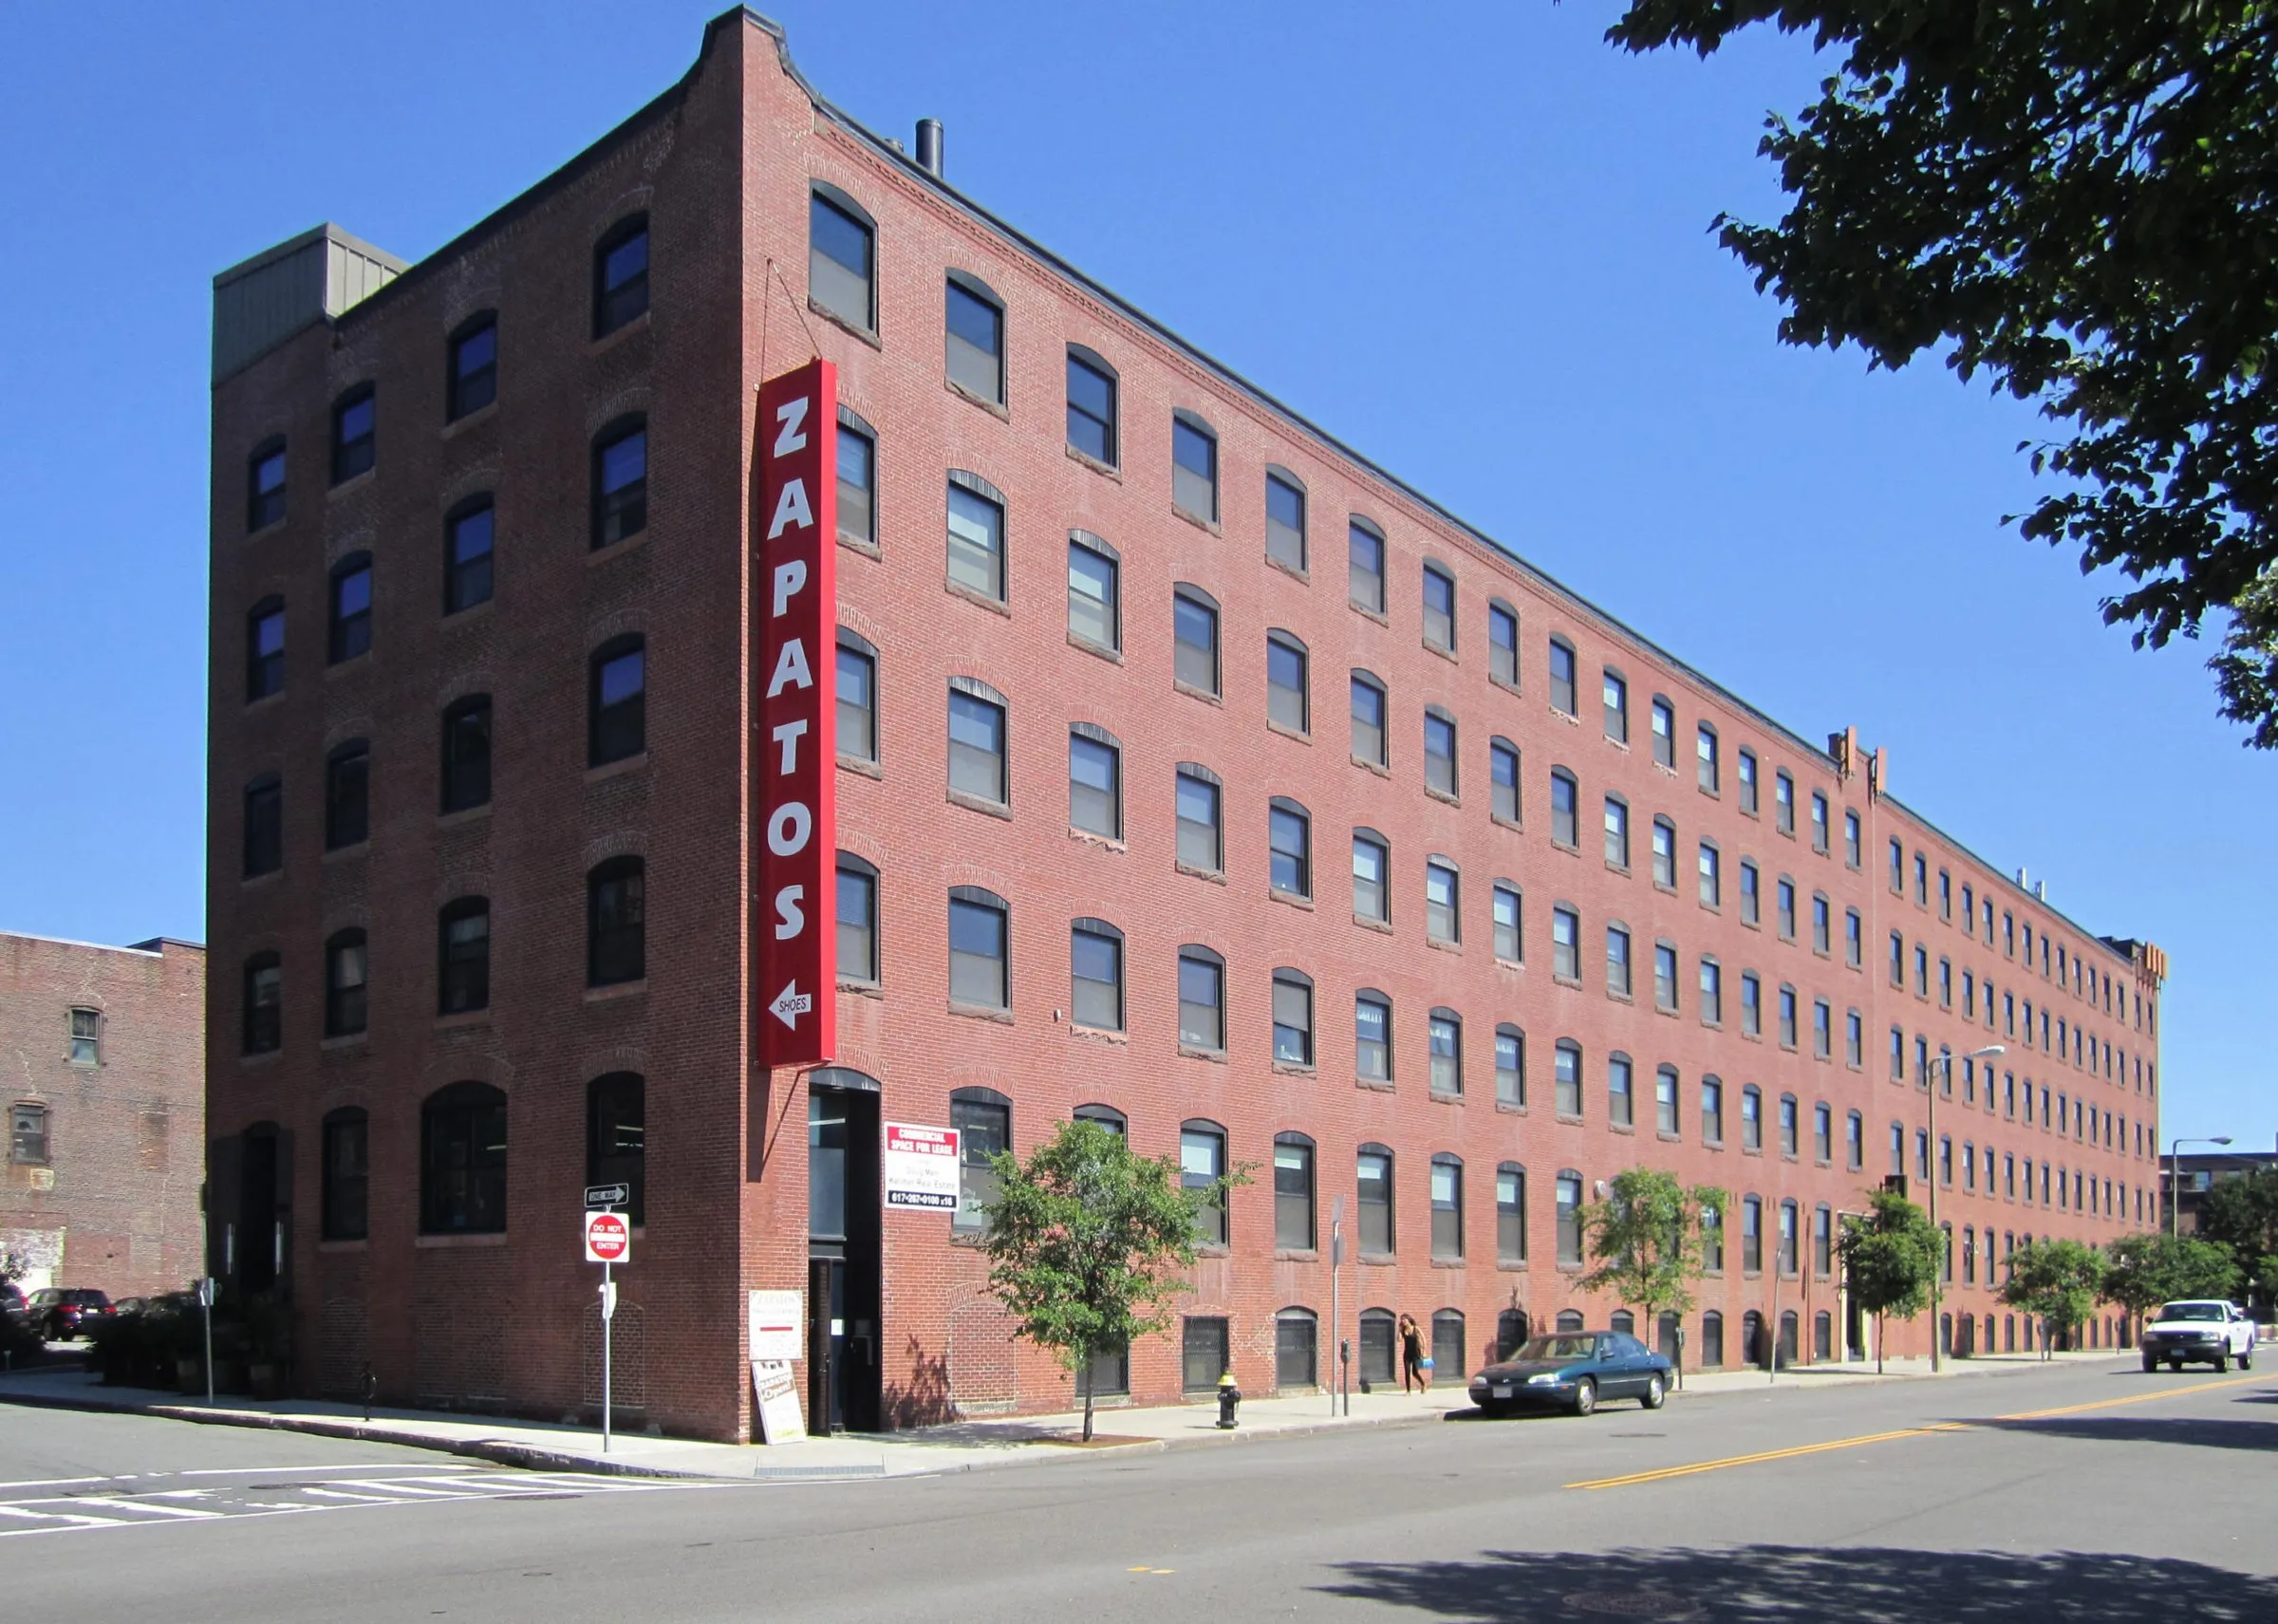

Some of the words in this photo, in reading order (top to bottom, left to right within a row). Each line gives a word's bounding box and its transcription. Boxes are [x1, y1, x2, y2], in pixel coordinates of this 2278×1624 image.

[767, 395, 813, 941] ZAPATOS
[779, 998, 807, 1013] SHOES
[898, 1128, 946, 1143] COMMERCIAL
[890, 1139, 914, 1151] SPACE
[916, 1142, 930, 1153] FOR
[932, 1143, 953, 1155] LEASE
[934, 1180, 956, 1189] Estate
[589, 1191, 602, 1201] ONE
[605, 1190, 616, 1199] WAY
[596, 1241, 620, 1250] ENTER
